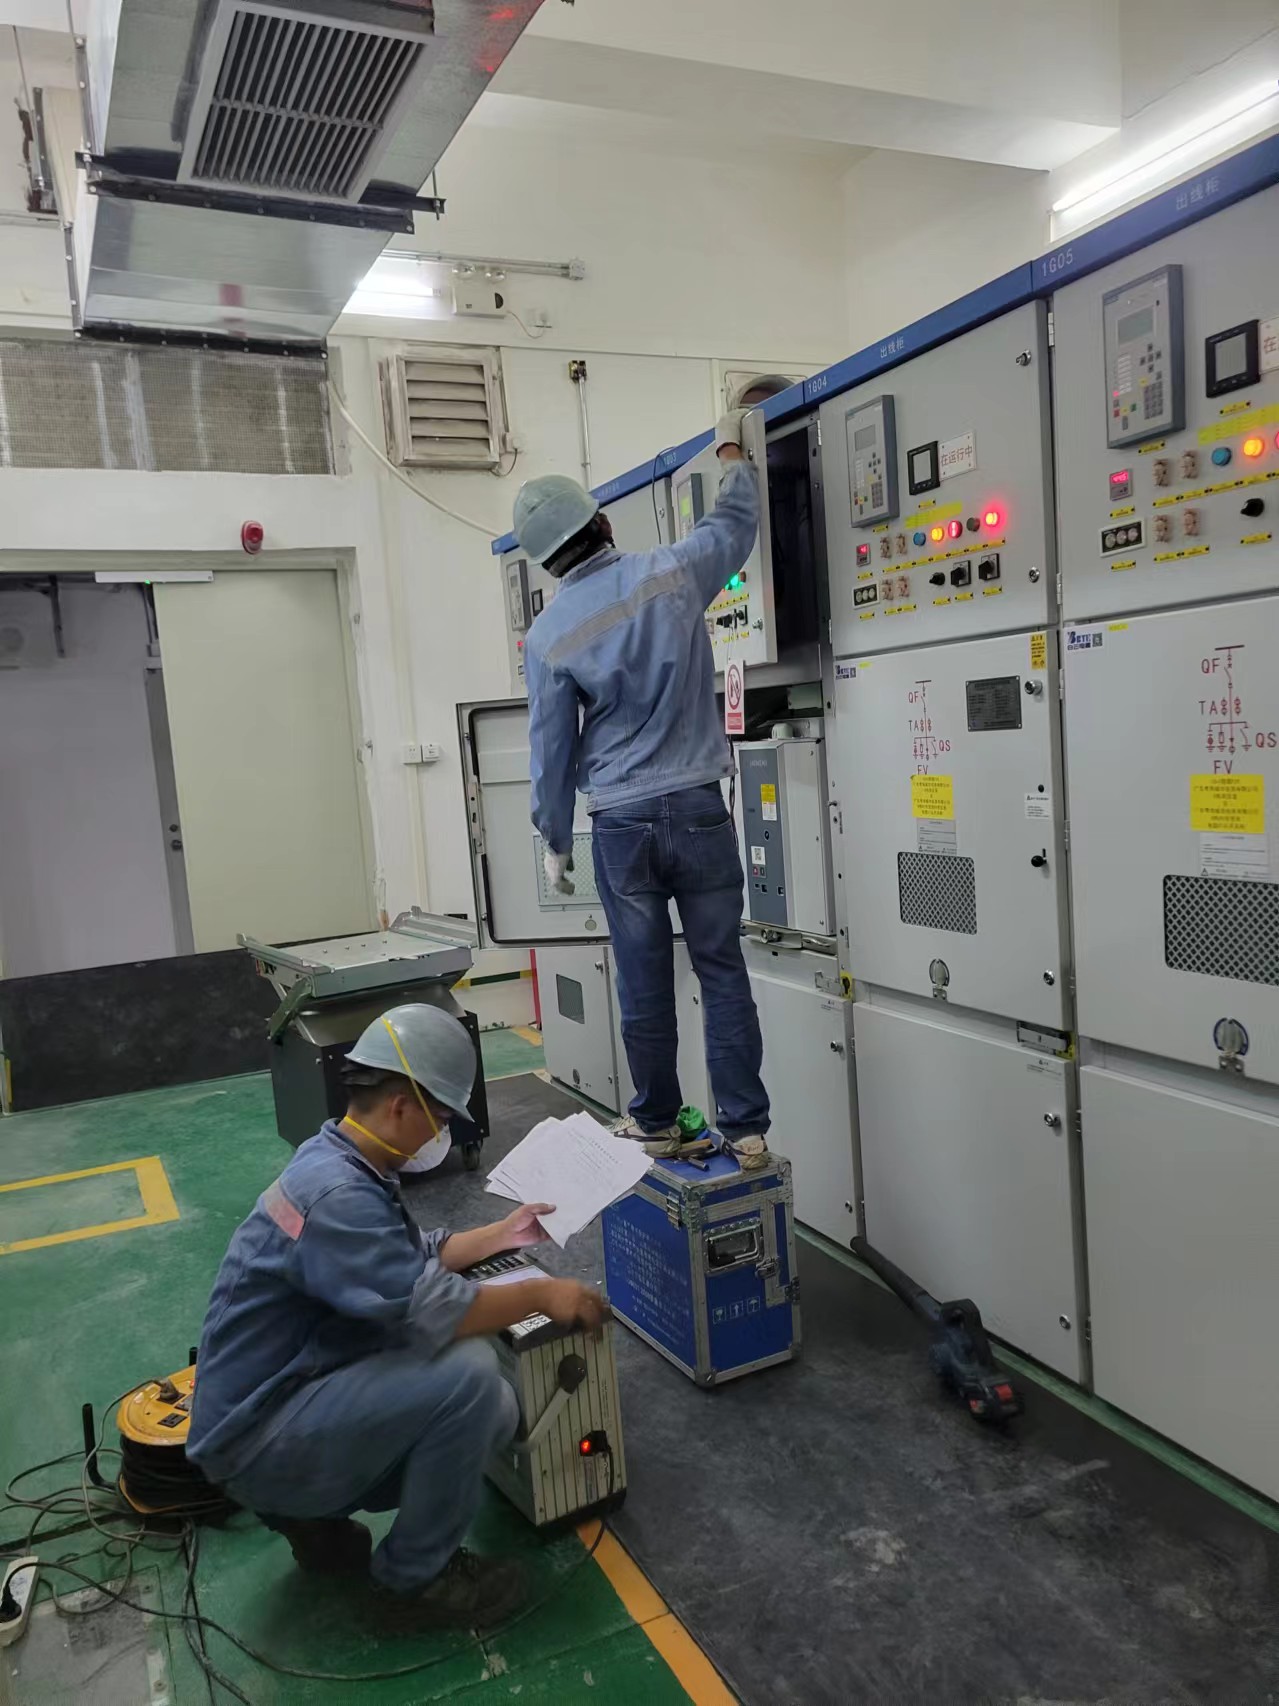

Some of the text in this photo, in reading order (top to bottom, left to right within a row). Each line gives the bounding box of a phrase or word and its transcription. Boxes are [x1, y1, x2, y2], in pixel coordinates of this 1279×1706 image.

[1176, 176, 1220, 211] 出线柜
[1041, 248, 1073, 277] 1G05
[880, 336, 904, 358] 出线柜
[808, 375, 827, 395] 1G04
[941, 445, 973, 467] 在运行中
[1201, 658, 1220, 674] QF
[908, 691, 919, 703] QF
[1199, 700, 1218, 715] TA
[908, 720, 919, 731] TA
[938, 739, 951, 752] QS
[1255, 732, 1277, 748] QS
[917, 765, 928, 775] FV
[1213, 760, 1232, 774] FV
